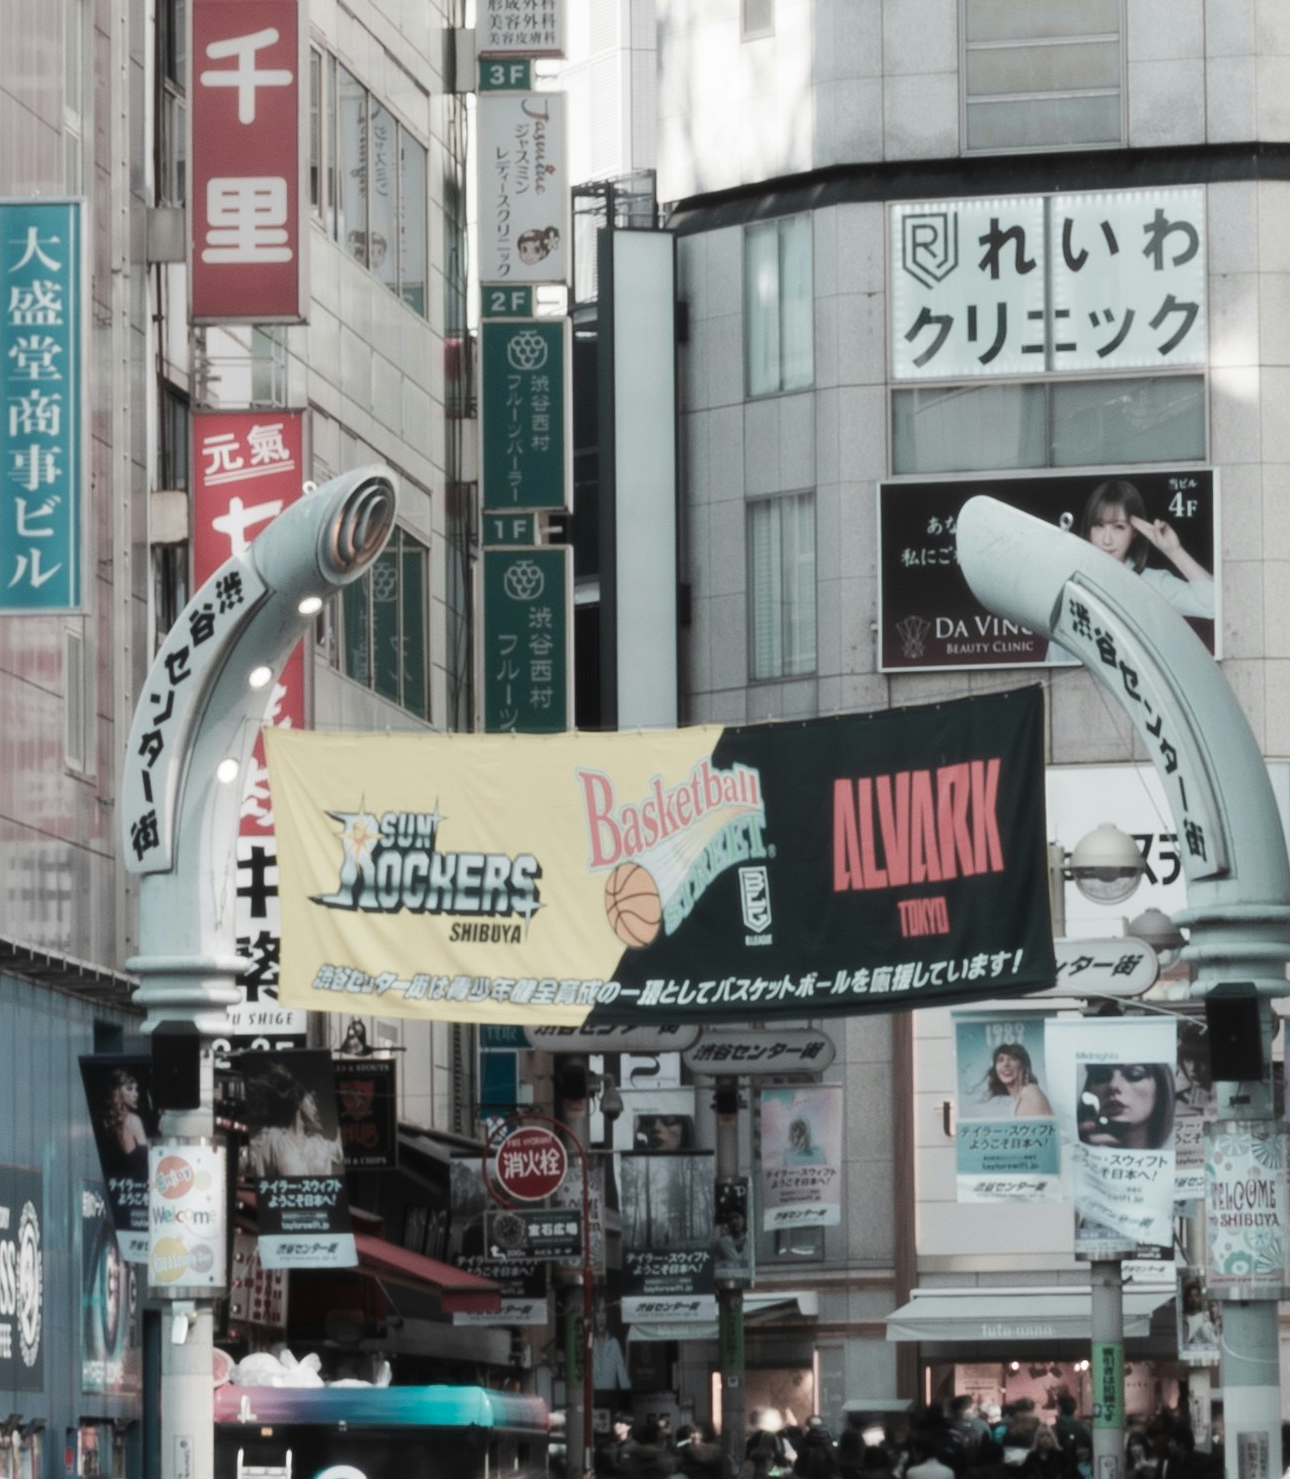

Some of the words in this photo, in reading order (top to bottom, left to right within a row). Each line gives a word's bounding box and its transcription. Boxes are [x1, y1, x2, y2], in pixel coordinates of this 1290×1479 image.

[489, 65, 524, 85] 3F
[978, 208, 1200, 281] れいわ
[490, 292, 526, 312] 2F
[904, 293, 1200, 369] クリニック
[7, 226, 65, 589] 大盛堂商事ビル
[530, 374, 551, 452] 渋谷西村
[1168, 492, 1198, 518] 4F
[494, 519, 528, 540] 1F
[528, 606, 554, 709] 渋谷西村
[946, 642, 990, 655] BEAUTY
[992, 640, 1034, 653] CLINIC
[130, 570, 244, 862] 渋谷センター街
[1067, 599, 1208, 863] 渋谷センター街
[379, 810, 437, 849] SUN
[576, 760, 766, 872] Basketball
[832, 758, 1005, 892] ALVARK
[448, 922, 523, 944] SHIBUYA
[897, 896, 950, 938] TOKYO
[692, 1041, 827, 1062] 渋谷センター街
[503, 1147, 561, 1179] 消火栓
[1221, 1213, 1281, 1227] SHIBUYA
